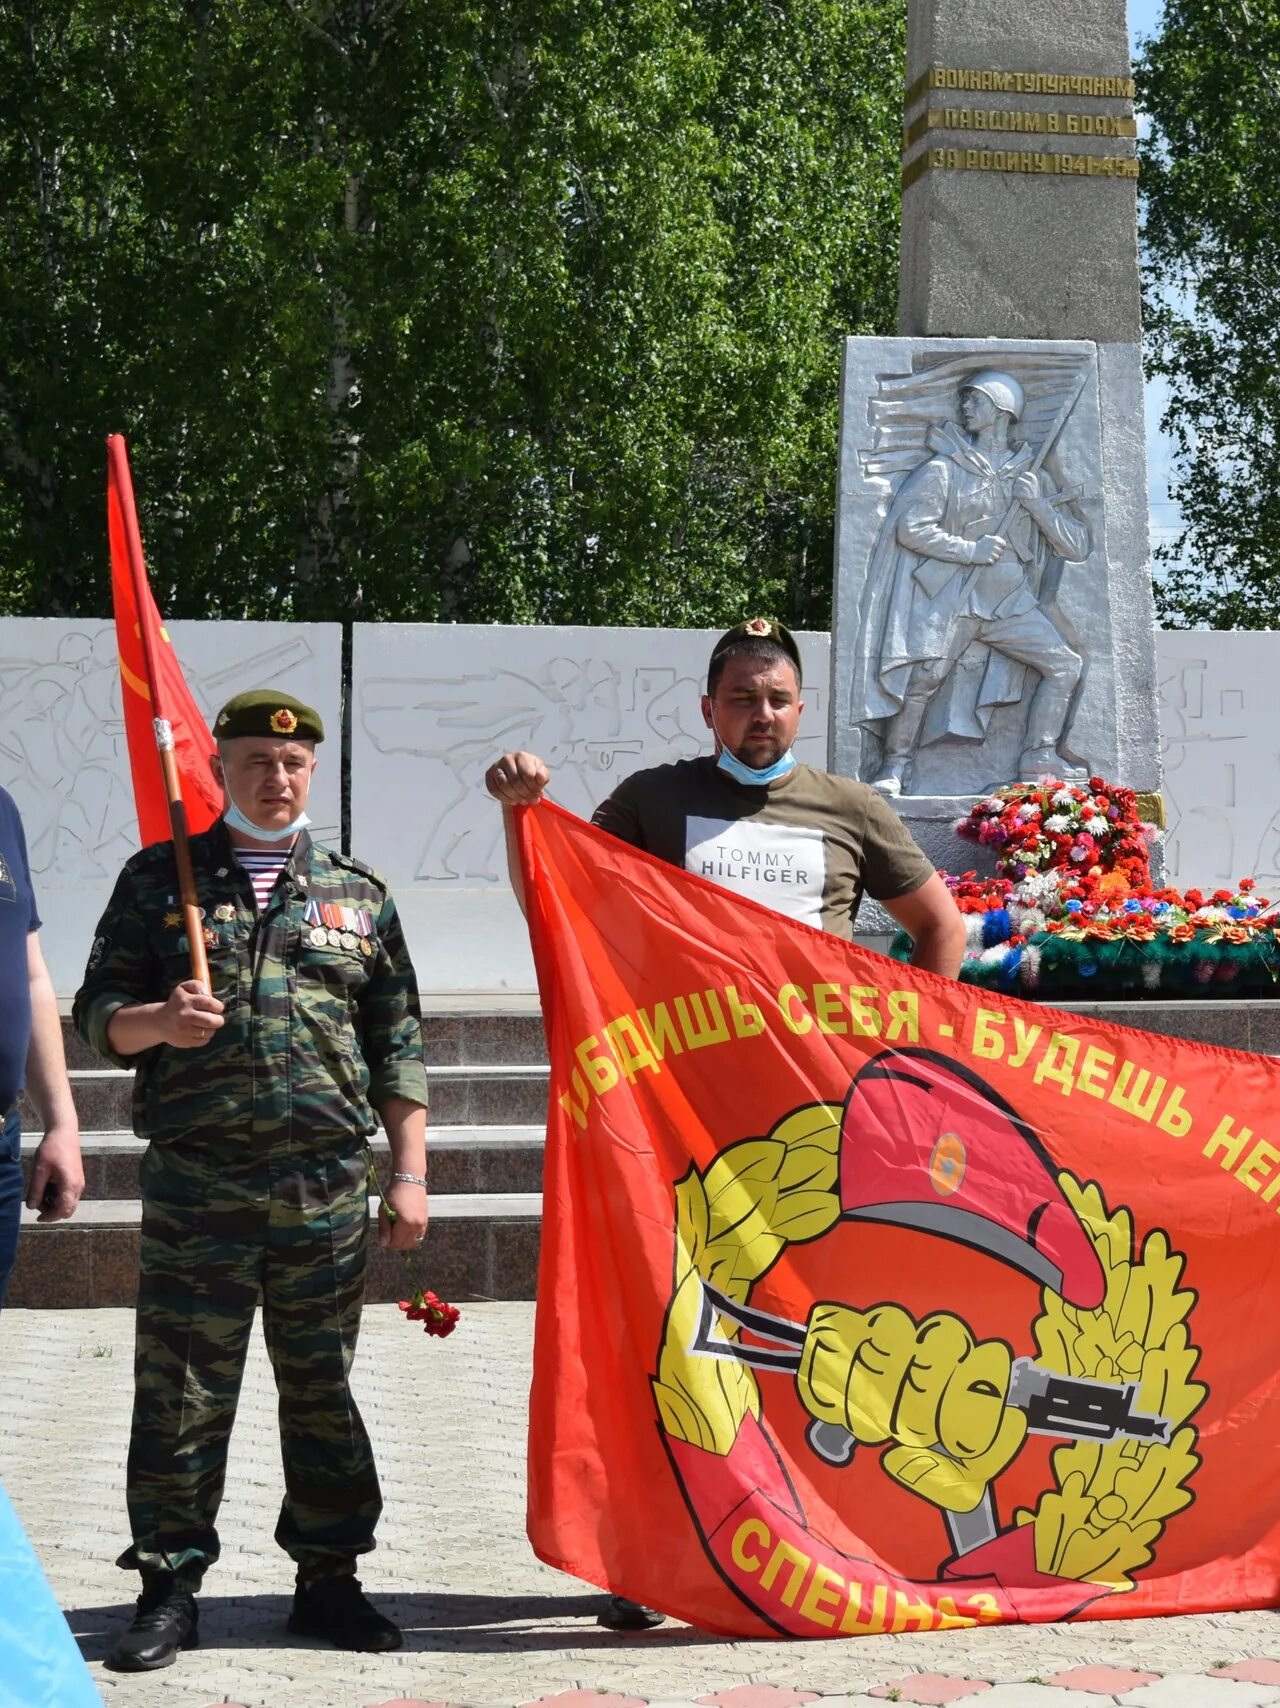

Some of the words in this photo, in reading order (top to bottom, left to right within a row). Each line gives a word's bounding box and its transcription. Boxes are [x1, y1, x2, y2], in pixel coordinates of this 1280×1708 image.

[945, 108, 1040, 132] ПАВШИМ
[1047, 113, 1059, 132] В
[1066, 114, 1121, 135] БОЯХ
[933, 148, 958, 168] ЗА
[966, 149, 1046, 172] РОДИНУ
[716, 846, 795, 867] TOMMY
[702, 861, 809, 885] HILFIGER
[778, 982, 921, 1043] СЕБЯ
[971, 1007, 1194, 1138] БУДЕШЬ
[730, 1517, 1002, 1635] СПЕЦНАЗ
